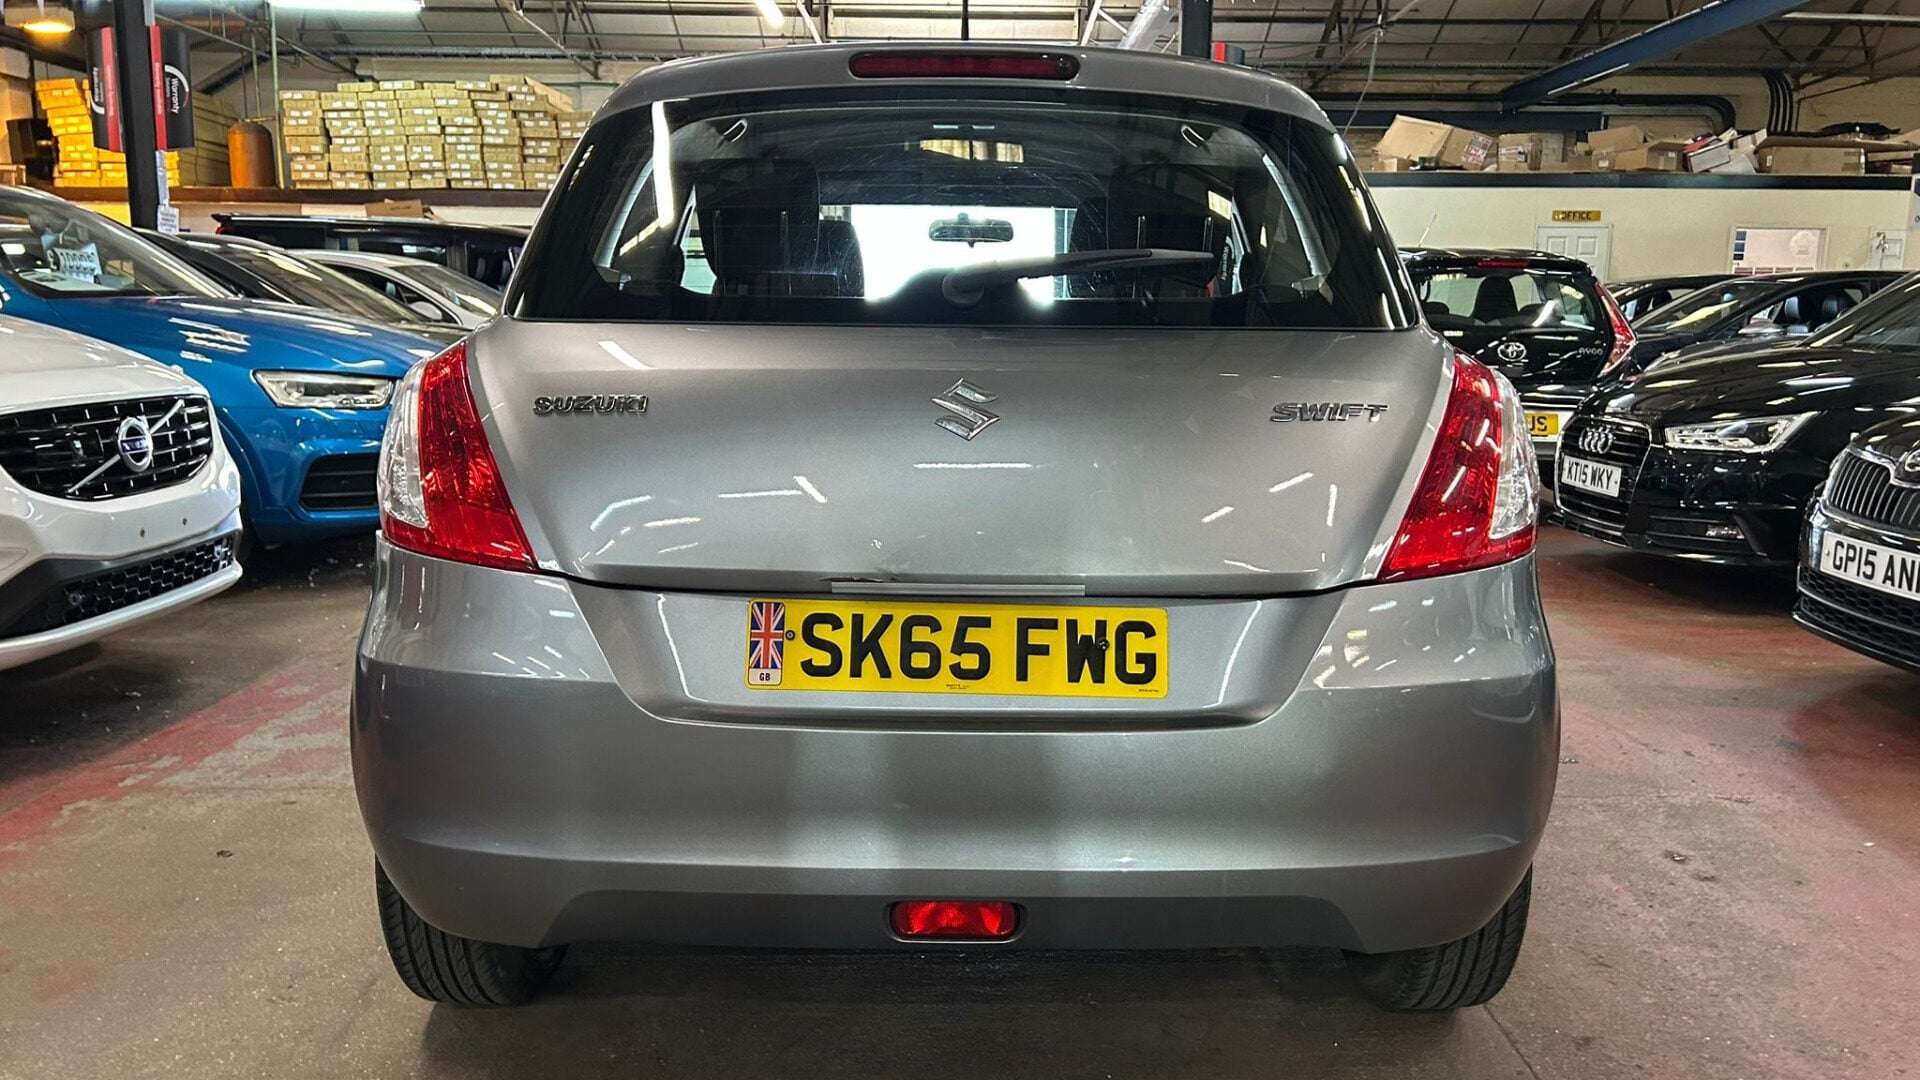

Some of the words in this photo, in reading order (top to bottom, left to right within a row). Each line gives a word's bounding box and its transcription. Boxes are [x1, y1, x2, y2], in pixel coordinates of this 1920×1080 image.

[533, 394, 649, 416] SUZUKI
[1270, 402, 1388, 422] SWIFT
[1530, 416, 1547, 432] JS
[1567, 460, 1588, 484] KT15
[1590, 465, 1614, 490] WKY
[1832, 540, 1877, 581] GP15
[800, 612, 992, 681] SK65
[1016, 617, 1157, 685] FWG
[759, 673, 771, 682] GB
